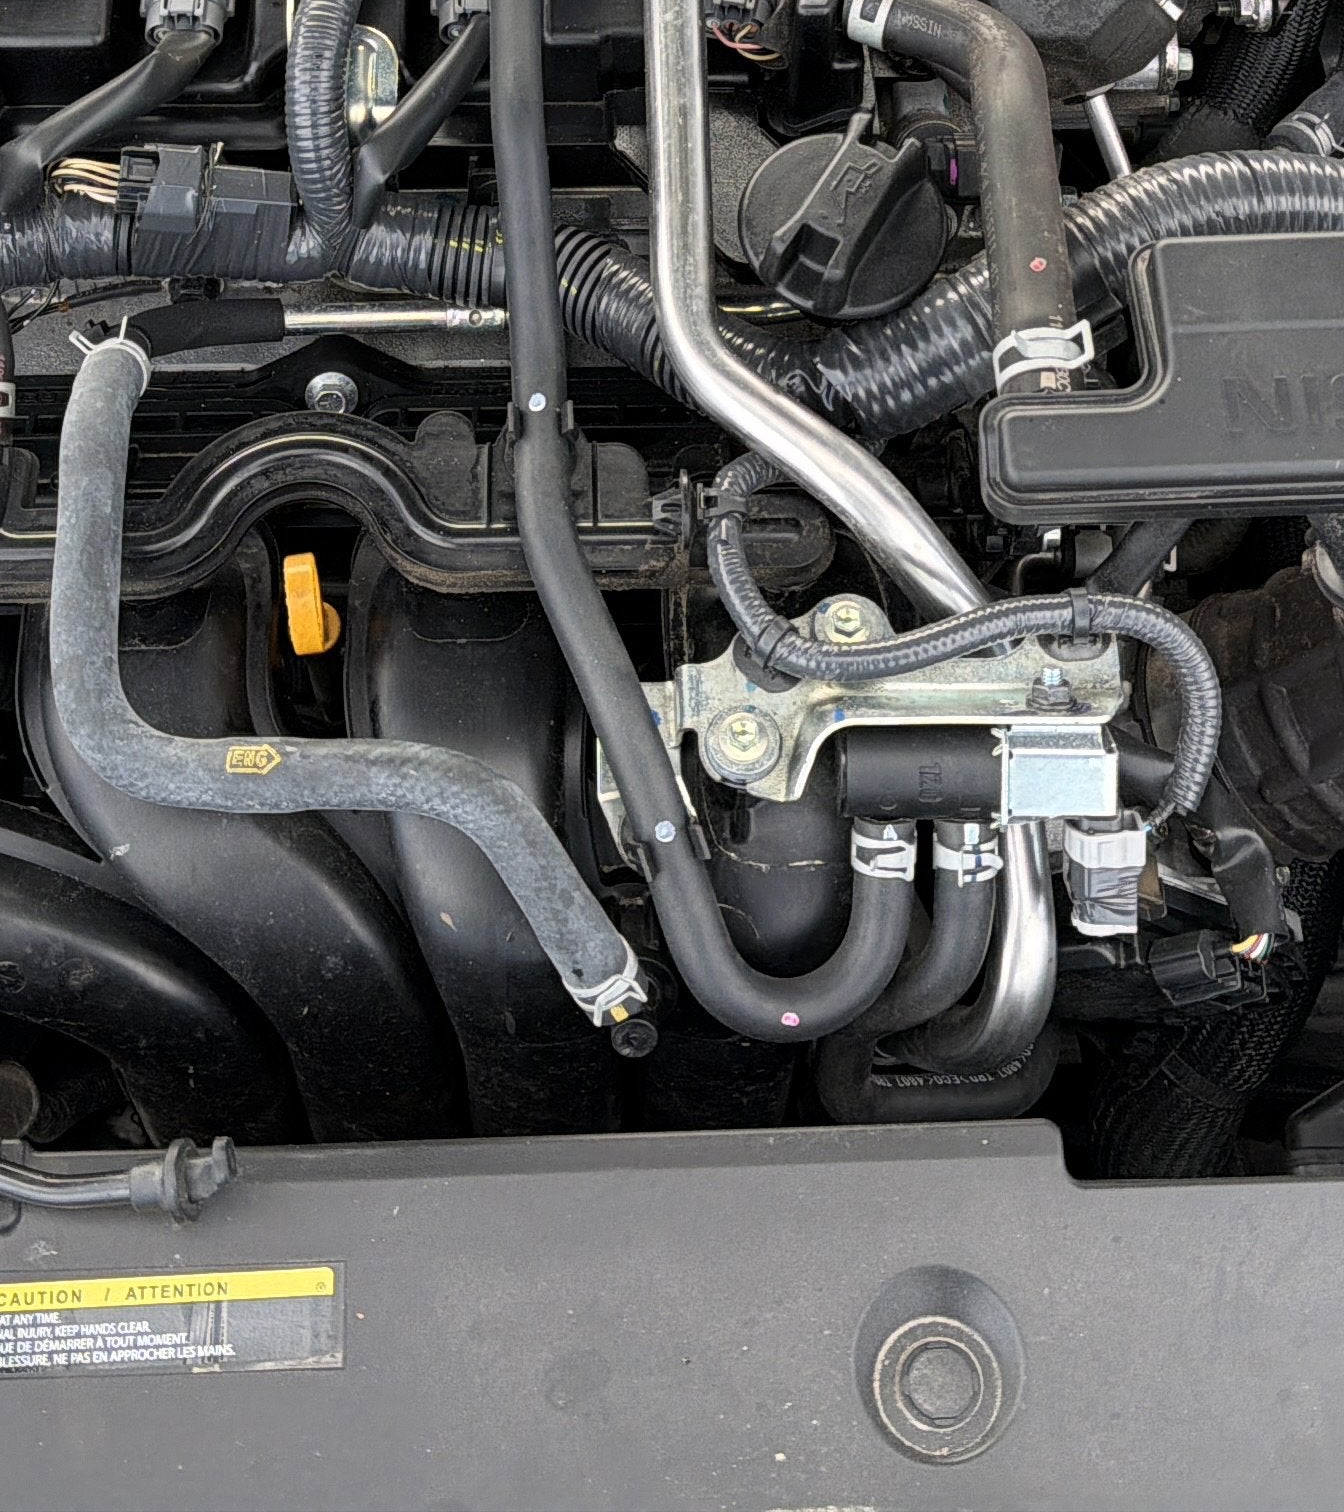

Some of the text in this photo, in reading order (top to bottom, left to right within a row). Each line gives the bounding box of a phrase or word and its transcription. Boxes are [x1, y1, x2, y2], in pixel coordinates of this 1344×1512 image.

[232, 750, 268, 767] ENG
[125, 1282, 228, 1300] ATTENTION
[0, 1314, 11, 1326] AT
[13, 1313, 35, 1326] ANY
[55, 1324, 80, 1337] KEEP
[81, 1323, 116, 1336] HANDS
[17, 1341, 32, 1353] DE
[34, 1337, 93, 1352] DÉMARRER
[106, 1334, 135, 1348] TOUT
[53, 1353, 68, 1366] NE
[71, 1352, 90, 1364] PAS
[93, 1352, 108, 1364] EN
[109, 1347, 175, 1362] APPROCHER
[177, 1345, 196, 1358] LES
